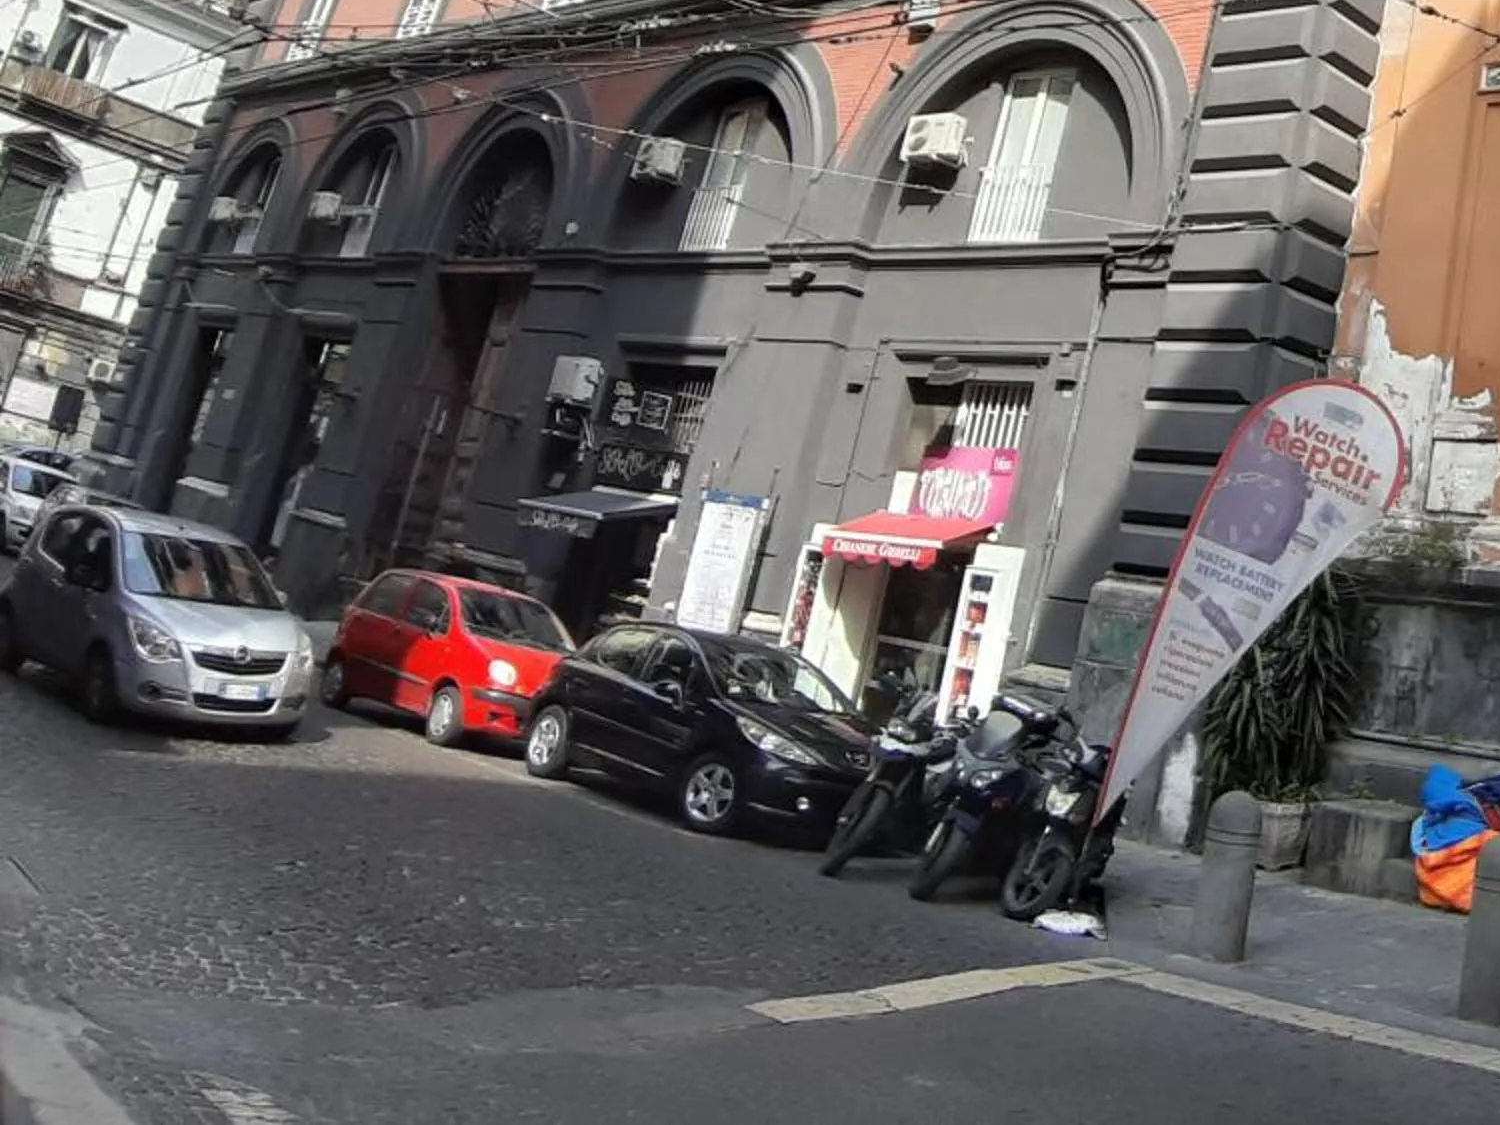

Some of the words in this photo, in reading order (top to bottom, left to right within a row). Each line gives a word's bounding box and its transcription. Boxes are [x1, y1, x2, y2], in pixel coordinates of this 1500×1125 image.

[1264, 418, 1381, 489] Repair
[1293, 415, 1360, 458] Watch
[1311, 471, 1368, 506] Services
